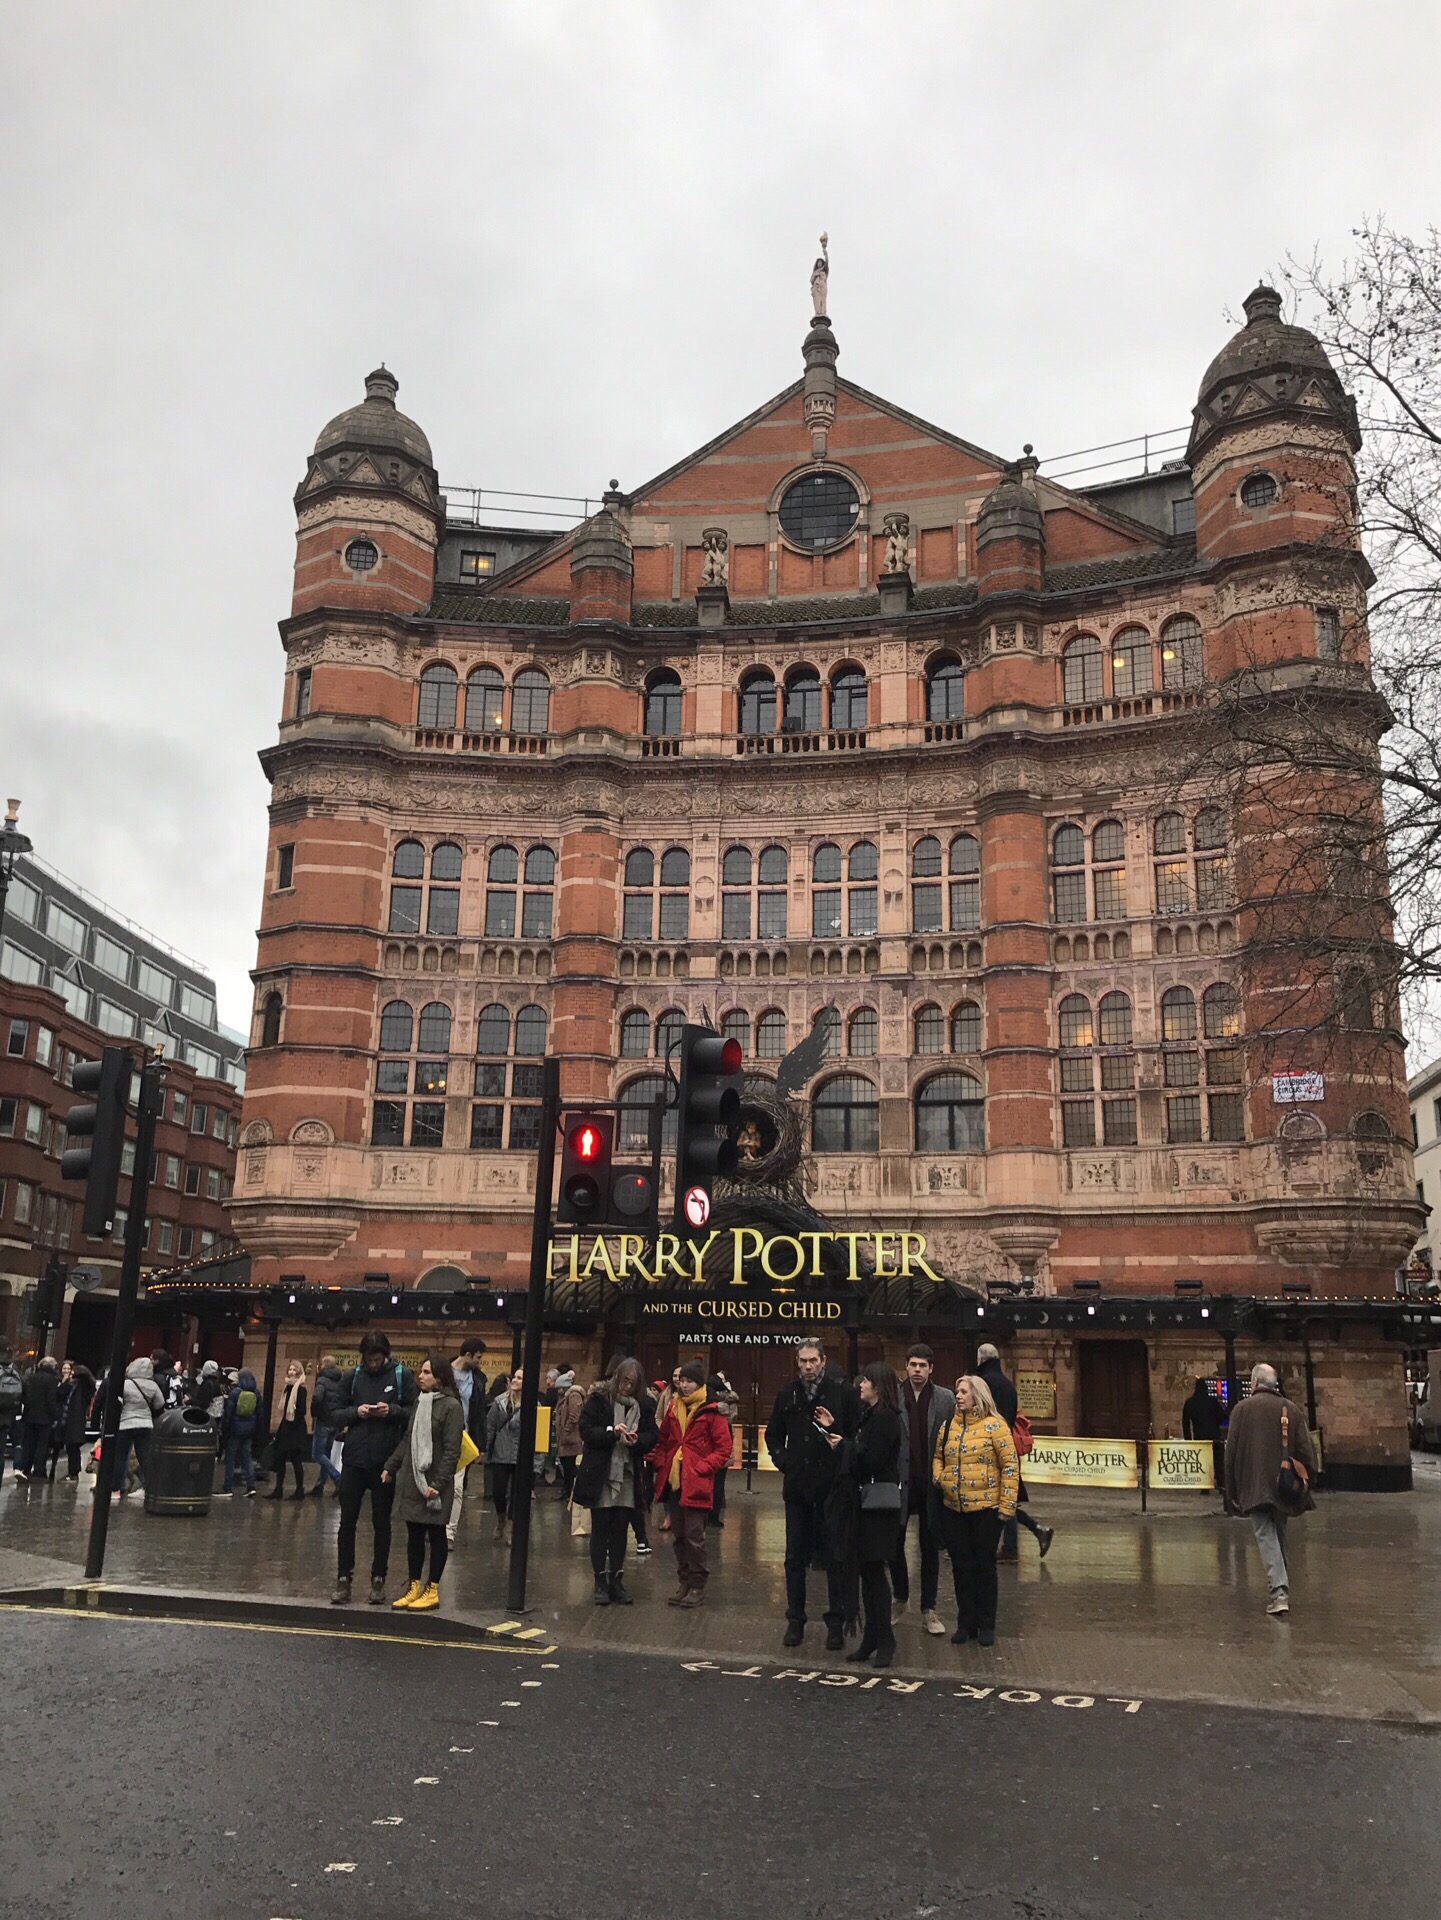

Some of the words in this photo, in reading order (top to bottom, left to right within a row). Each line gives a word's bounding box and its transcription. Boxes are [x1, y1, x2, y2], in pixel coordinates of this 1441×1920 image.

[545, 1230, 721, 1283] HARRY
[729, 1227, 945, 1285] POTTER
[643, 1303, 669, 1314] AND
[671, 1303, 693, 1314] THE
[697, 1300, 773, 1319] CURSED
[778, 1301, 841, 1319] CHILD
[679, 1333, 713, 1344] PARTS
[717, 1333, 741, 1344] ONE
[744, 1334, 770, 1345] AND
[773, 1335, 801, 1345] TWO
[1027, 1448, 1072, 1466] HARRY
[1075, 1449, 1130, 1468] POTTER
[1159, 1447, 1203, 1462] HARRY
[1064, 1466, 1087, 1474] CURSED
[1157, 1460, 1206, 1475] POTTER
[720, 1664, 925, 1693] RIGHT
[953, 1684, 1144, 1714] LOOK
